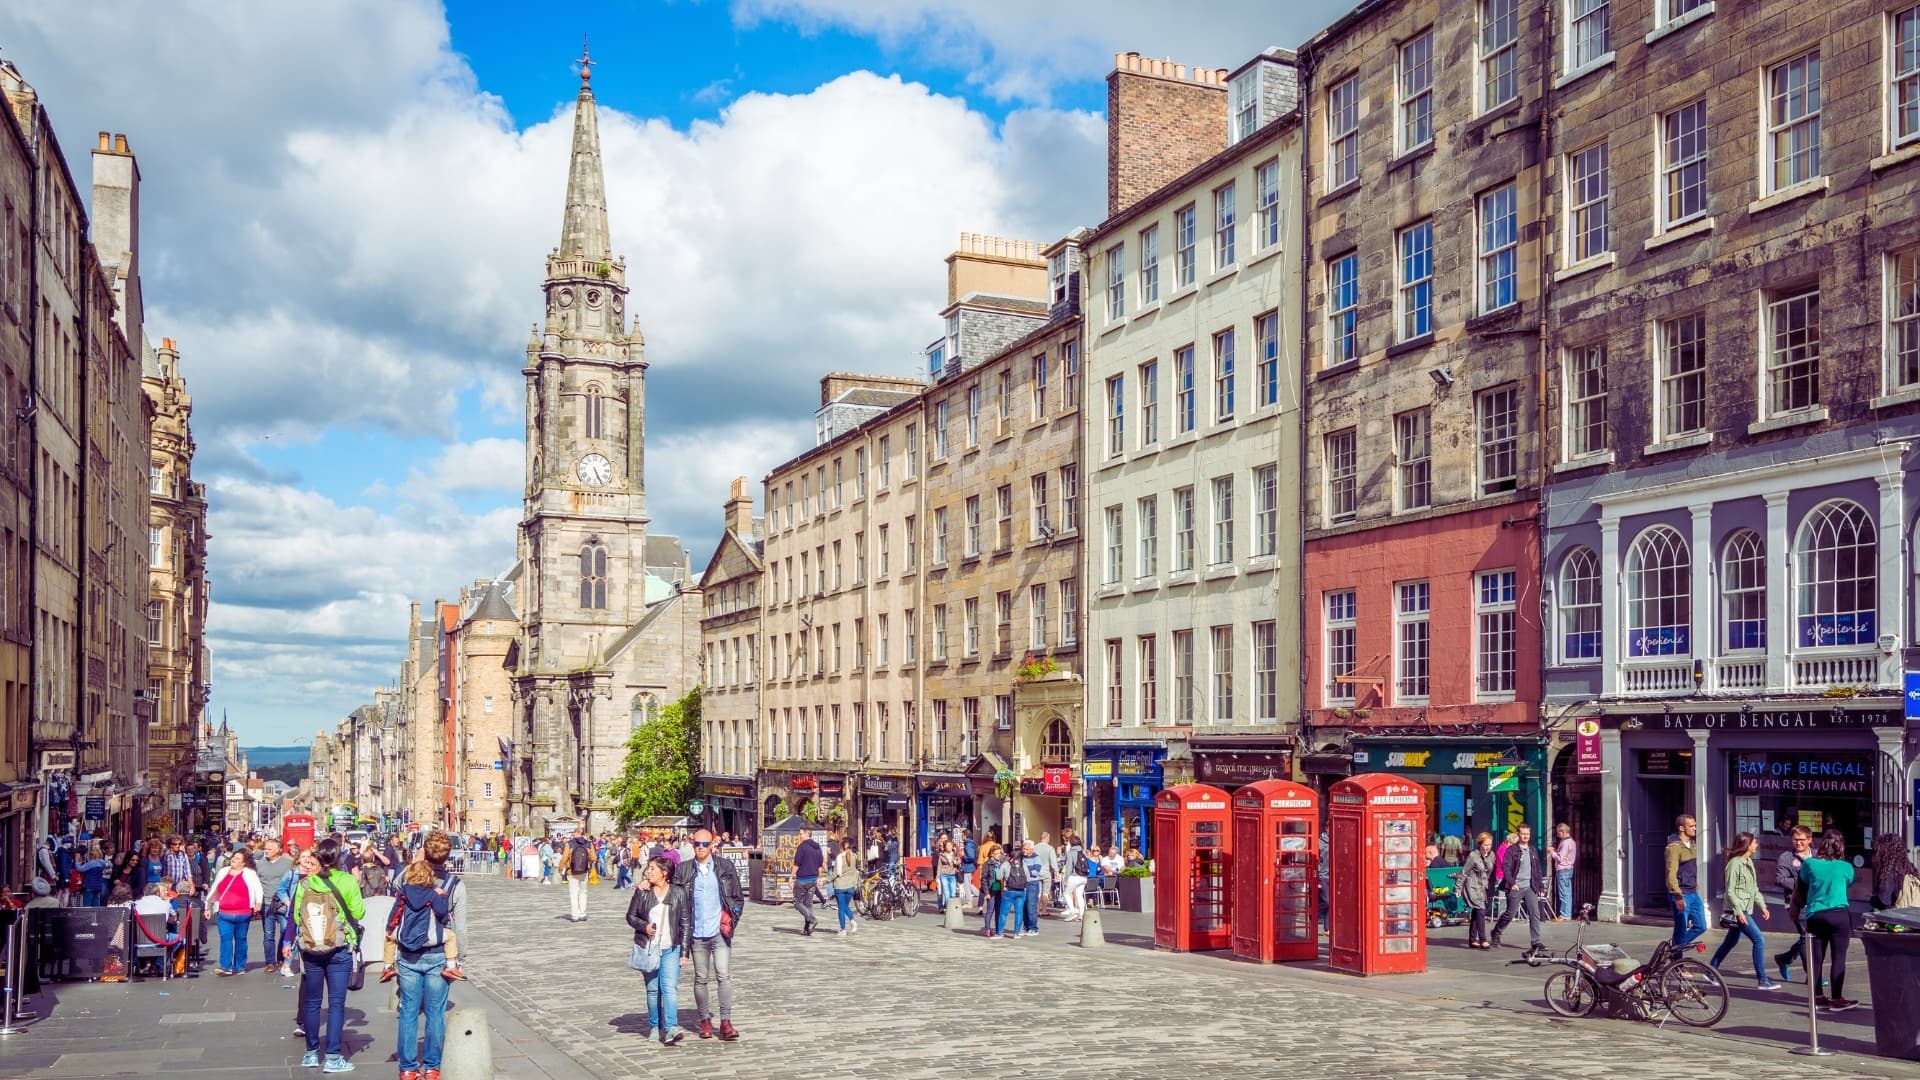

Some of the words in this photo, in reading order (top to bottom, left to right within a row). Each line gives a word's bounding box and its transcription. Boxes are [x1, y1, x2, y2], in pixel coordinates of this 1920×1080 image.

[1664, 714, 1694, 728] BAY
[1705, 713, 1727, 728] OF
[1739, 712, 1817, 727] BENGAL
[1861, 714, 1888, 724] 1978
[1385, 751, 1431, 768] SUBWAY
[1738, 761, 1767, 775] BAY
[1772, 761, 1792, 776] OF
[1799, 761, 1865, 777] BENGAL
[1739, 778, 1780, 790] INDIAN
[1783, 779, 1865, 792] RESTAURANT
[779, 835, 801, 847] FRE
